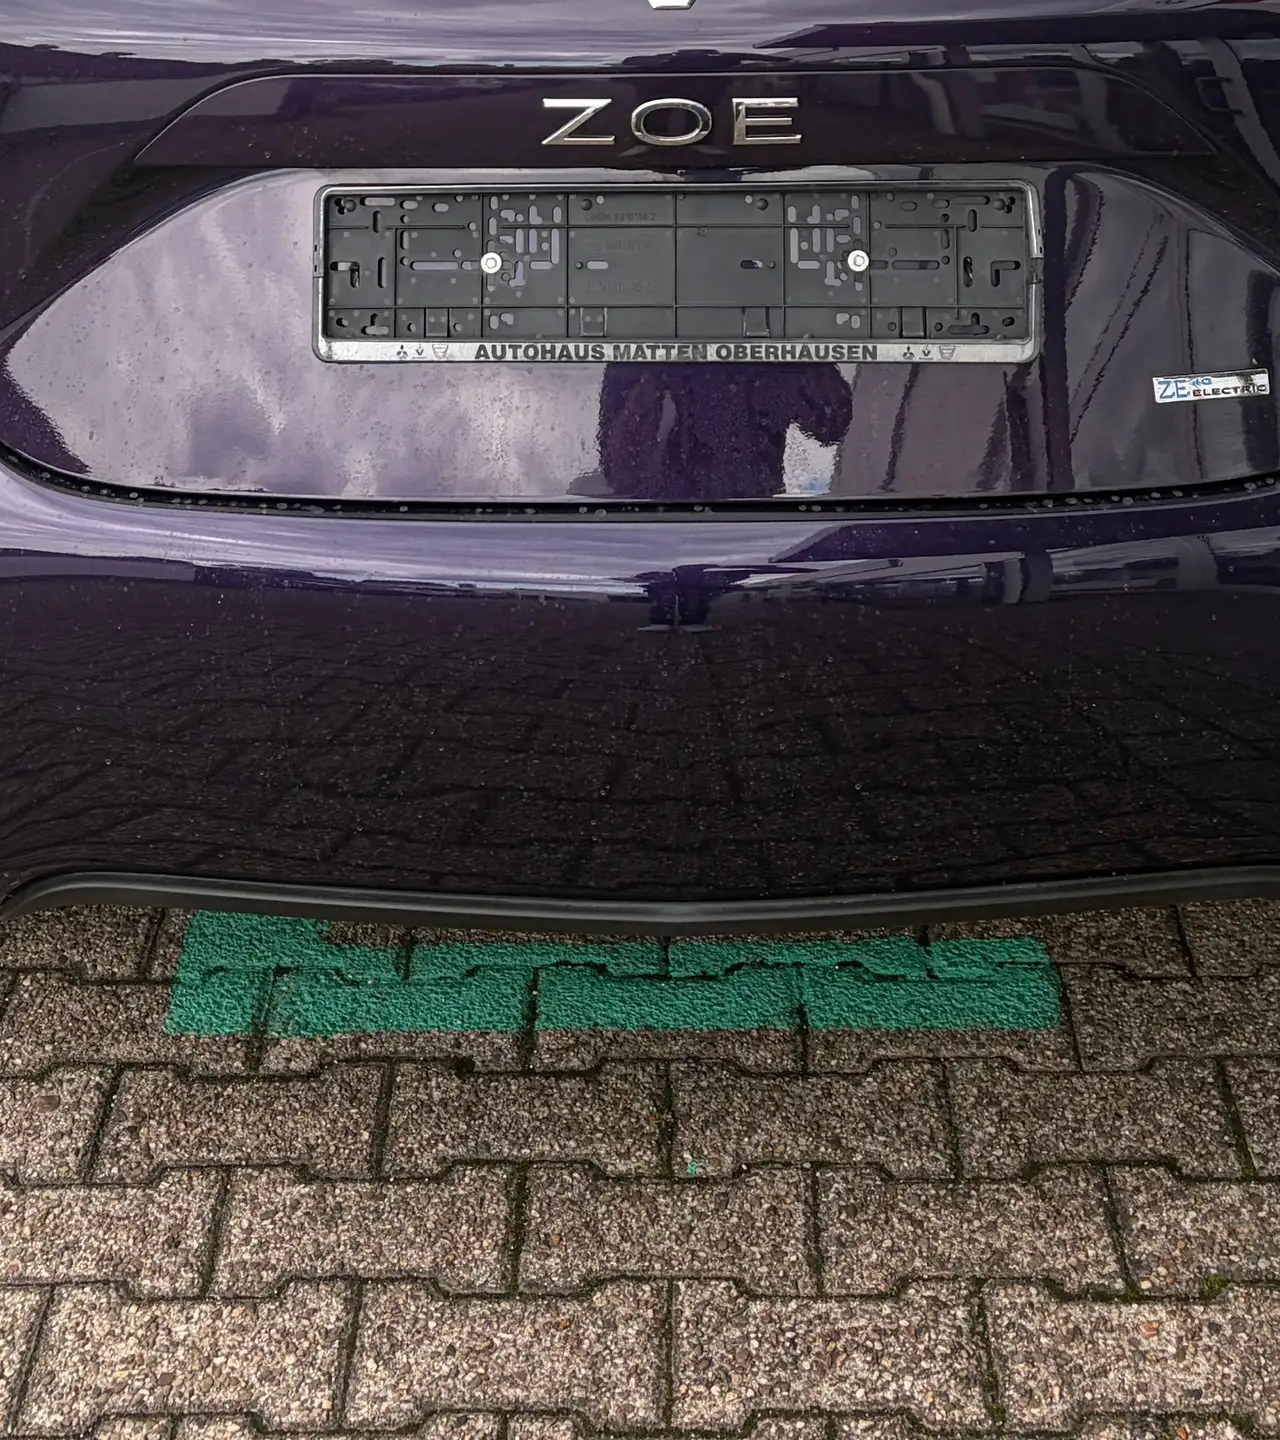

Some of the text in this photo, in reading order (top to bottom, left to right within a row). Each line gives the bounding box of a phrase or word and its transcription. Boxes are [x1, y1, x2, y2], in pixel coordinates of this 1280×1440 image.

[540, 96, 804, 147] ZOE
[474, 343, 878, 362] AUTOHAUS MATTEN OBERHAUSEN
[1191, 383, 1267, 398] ELECTRIC
